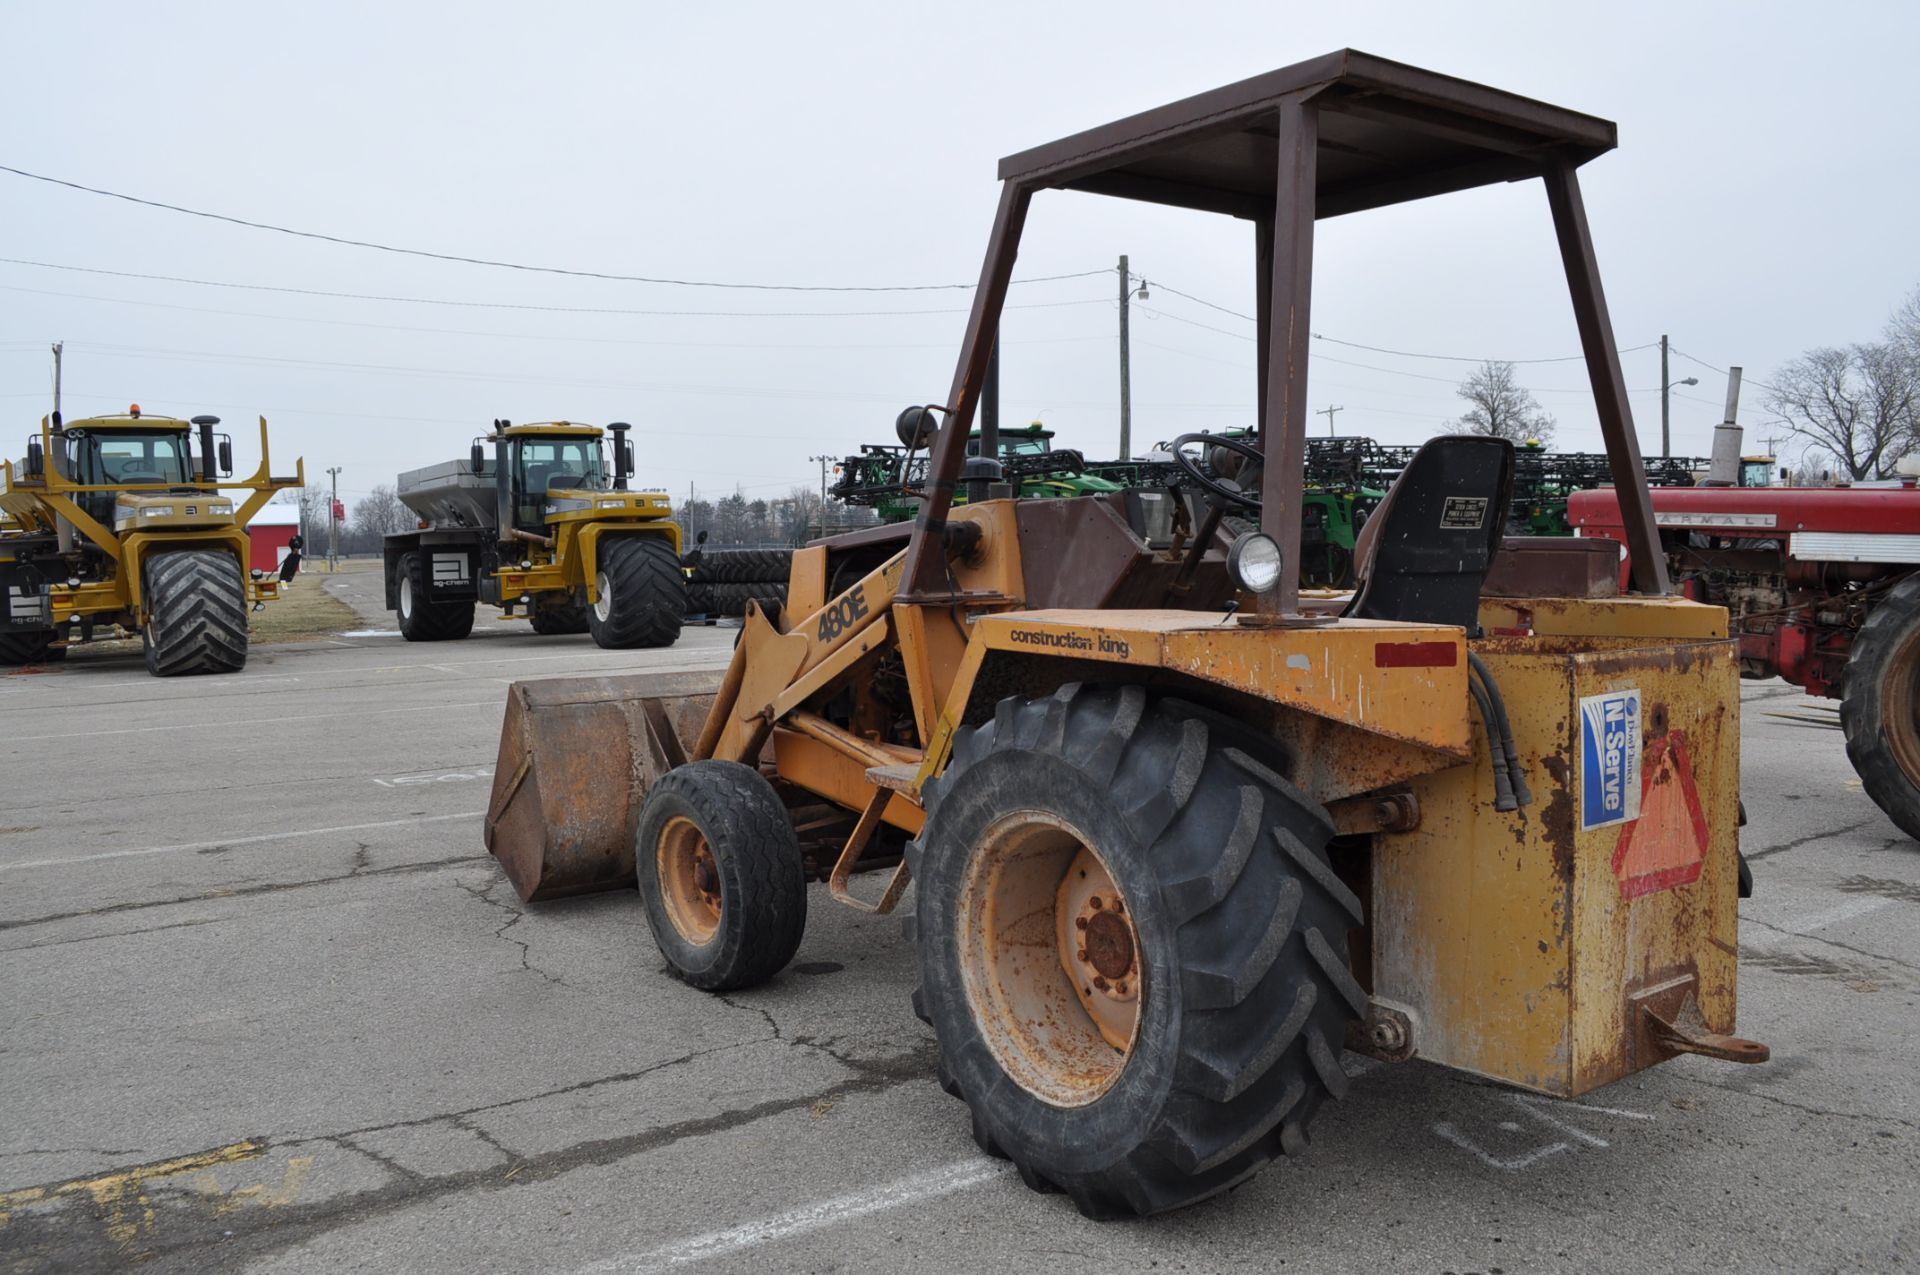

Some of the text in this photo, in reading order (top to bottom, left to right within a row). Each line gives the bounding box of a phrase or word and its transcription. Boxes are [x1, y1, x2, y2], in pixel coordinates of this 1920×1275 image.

[1660, 515, 1774, 526] ARMALL
[818, 582, 869, 644] 480E
[1011, 629, 1129, 659] construction king
[1605, 701, 1625, 812] N-Serve
